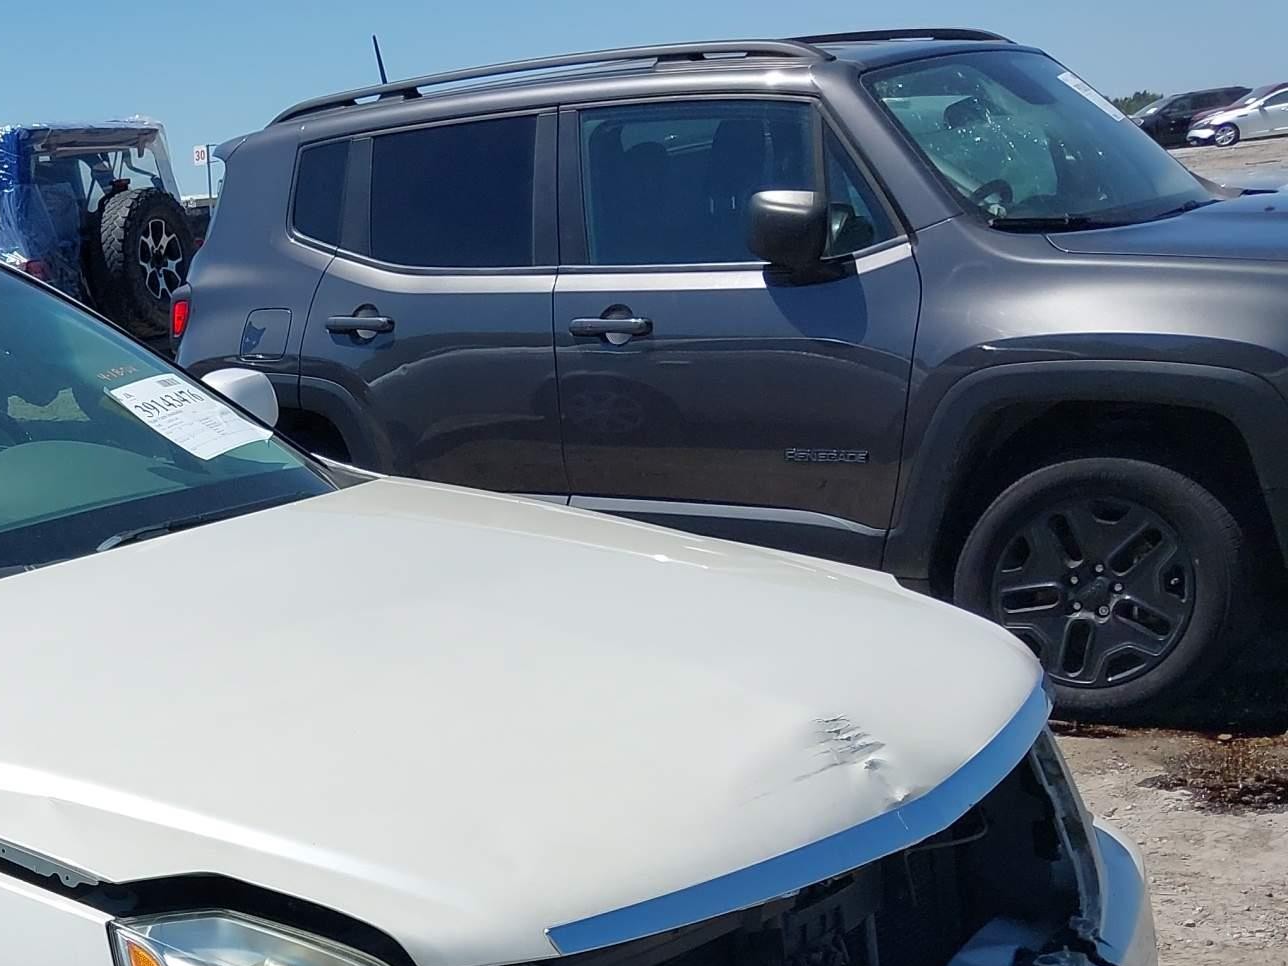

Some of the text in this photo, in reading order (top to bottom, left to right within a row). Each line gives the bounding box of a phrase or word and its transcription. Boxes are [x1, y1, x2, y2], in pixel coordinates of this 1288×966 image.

[195, 150, 206, 161] 30
[134, 388, 205, 418] 39143476
[784, 448, 869, 463] RENEGADE
